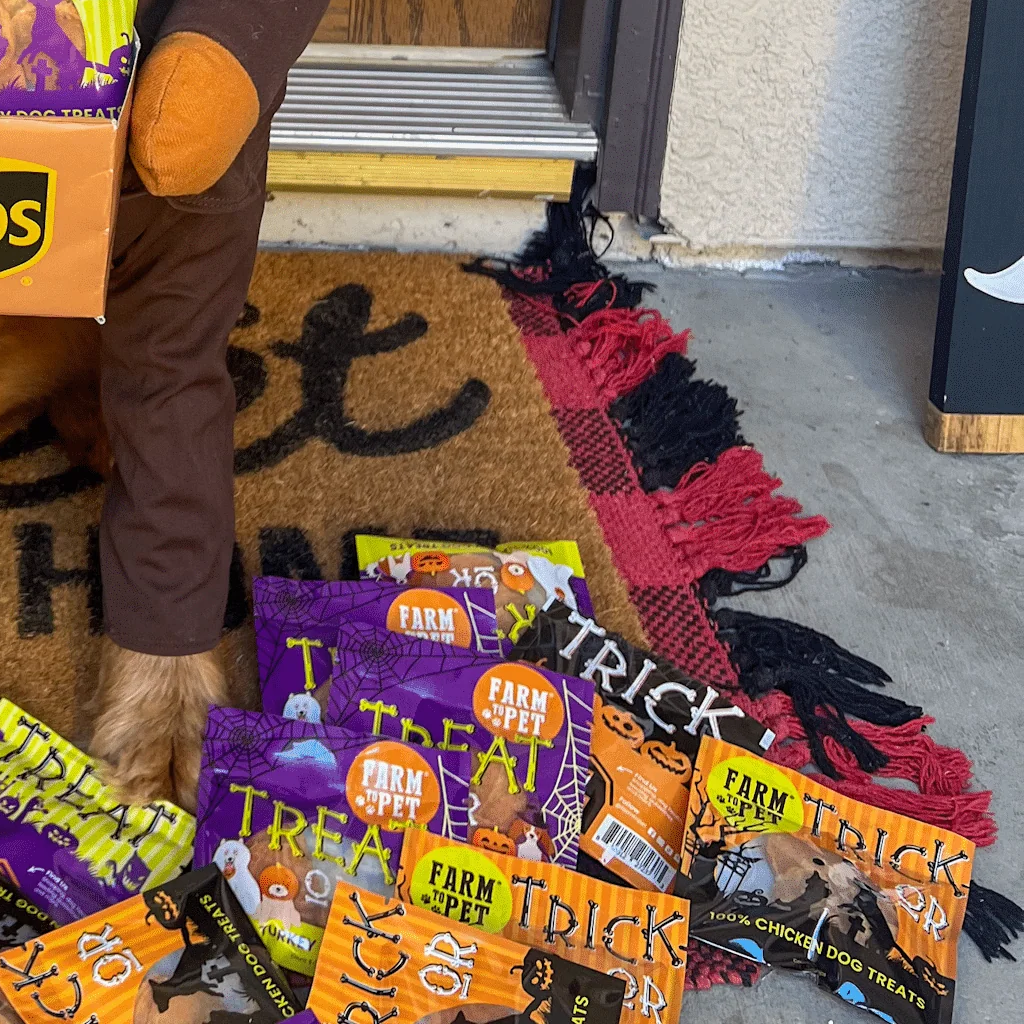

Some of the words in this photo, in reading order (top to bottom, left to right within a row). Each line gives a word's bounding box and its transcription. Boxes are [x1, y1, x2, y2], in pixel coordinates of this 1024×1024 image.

[399, 605, 455, 631] FARM
[488, 676, 550, 714] FARM
[559, 611, 745, 739] TRICK
[492, 703, 505, 717] TO
[503, 706, 547, 736] PET
[359, 699, 555, 794] TREAT
[0, 716, 176, 847] TREAT
[361, 759, 425, 796] FARM
[724, 768, 789, 816] FARM
[366, 789, 378, 802] TO
[376, 790, 422, 820] PET
[727, 793, 739, 807] TO
[736, 800, 784, 826] PET
[804, 793, 969, 898] TRICK
[304, 869, 334, 907] O
[428, 861, 496, 904] FARM
[432, 889, 445, 903] TO
[444, 894, 491, 926] PET
[14, 898, 50, 922] DOG
[512, 874, 685, 967] TRICK
[894, 883, 949, 941] OR
[76, 923, 144, 987] OR
[199, 895, 241, 943] TREATS
[237, 942, 267, 977] DOG
[261, 977, 295, 1018] CKEN
[337, 891, 407, 1024] RICK
[418, 931, 479, 1001] OR
[709, 911, 751, 927] 100%
[755, 918, 824, 954] CHICKEN
[826, 944, 864, 973] DOG
[867, 966, 927, 1011] TREATS
